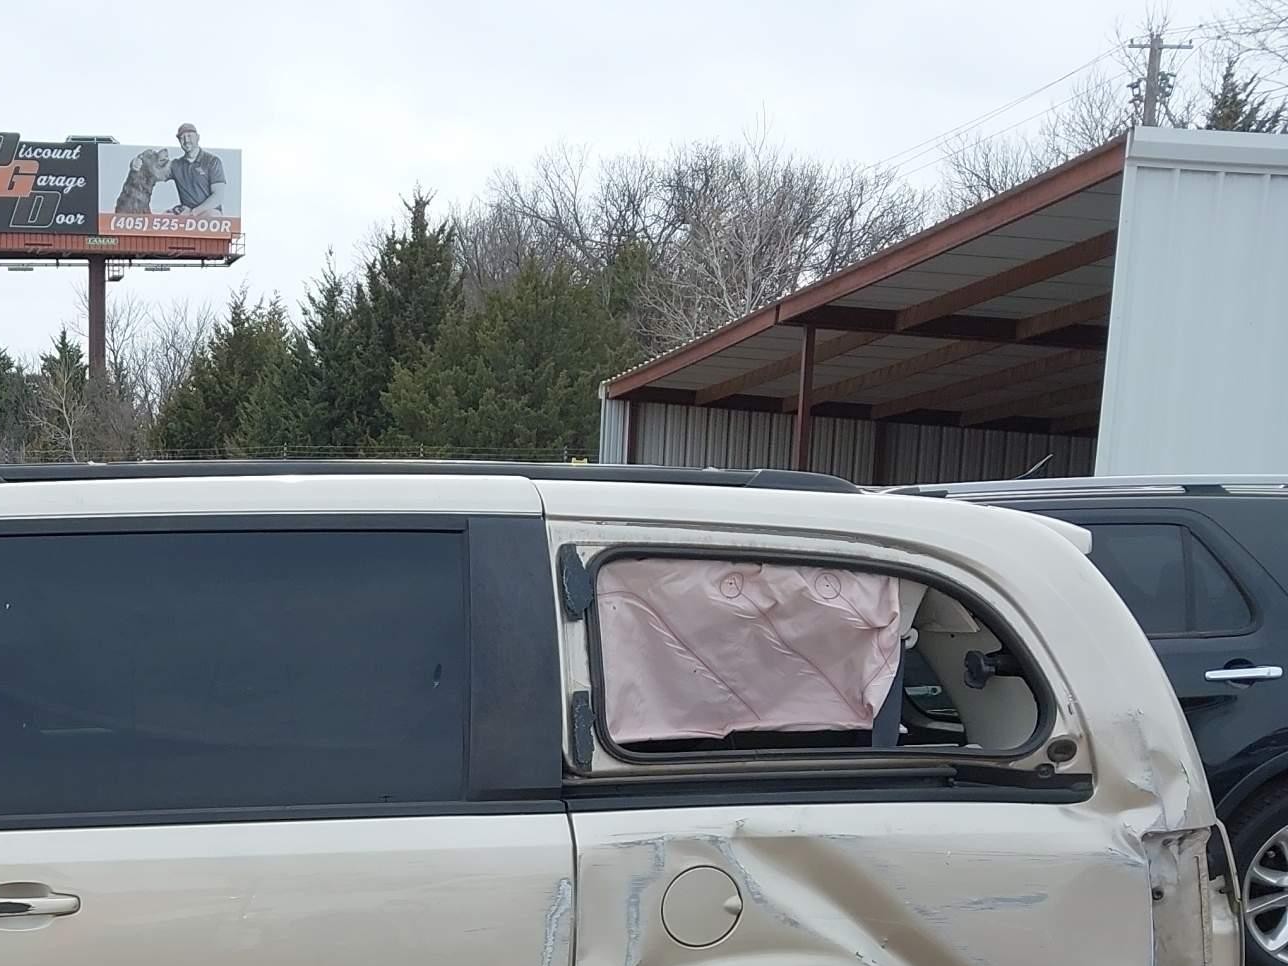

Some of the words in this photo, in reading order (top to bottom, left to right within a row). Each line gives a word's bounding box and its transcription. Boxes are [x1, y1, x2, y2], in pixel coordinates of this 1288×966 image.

[9, 191, 86, 228] Door
[110, 216, 149, 231] (405)
[152, 218, 232, 233] 525-DOOR
